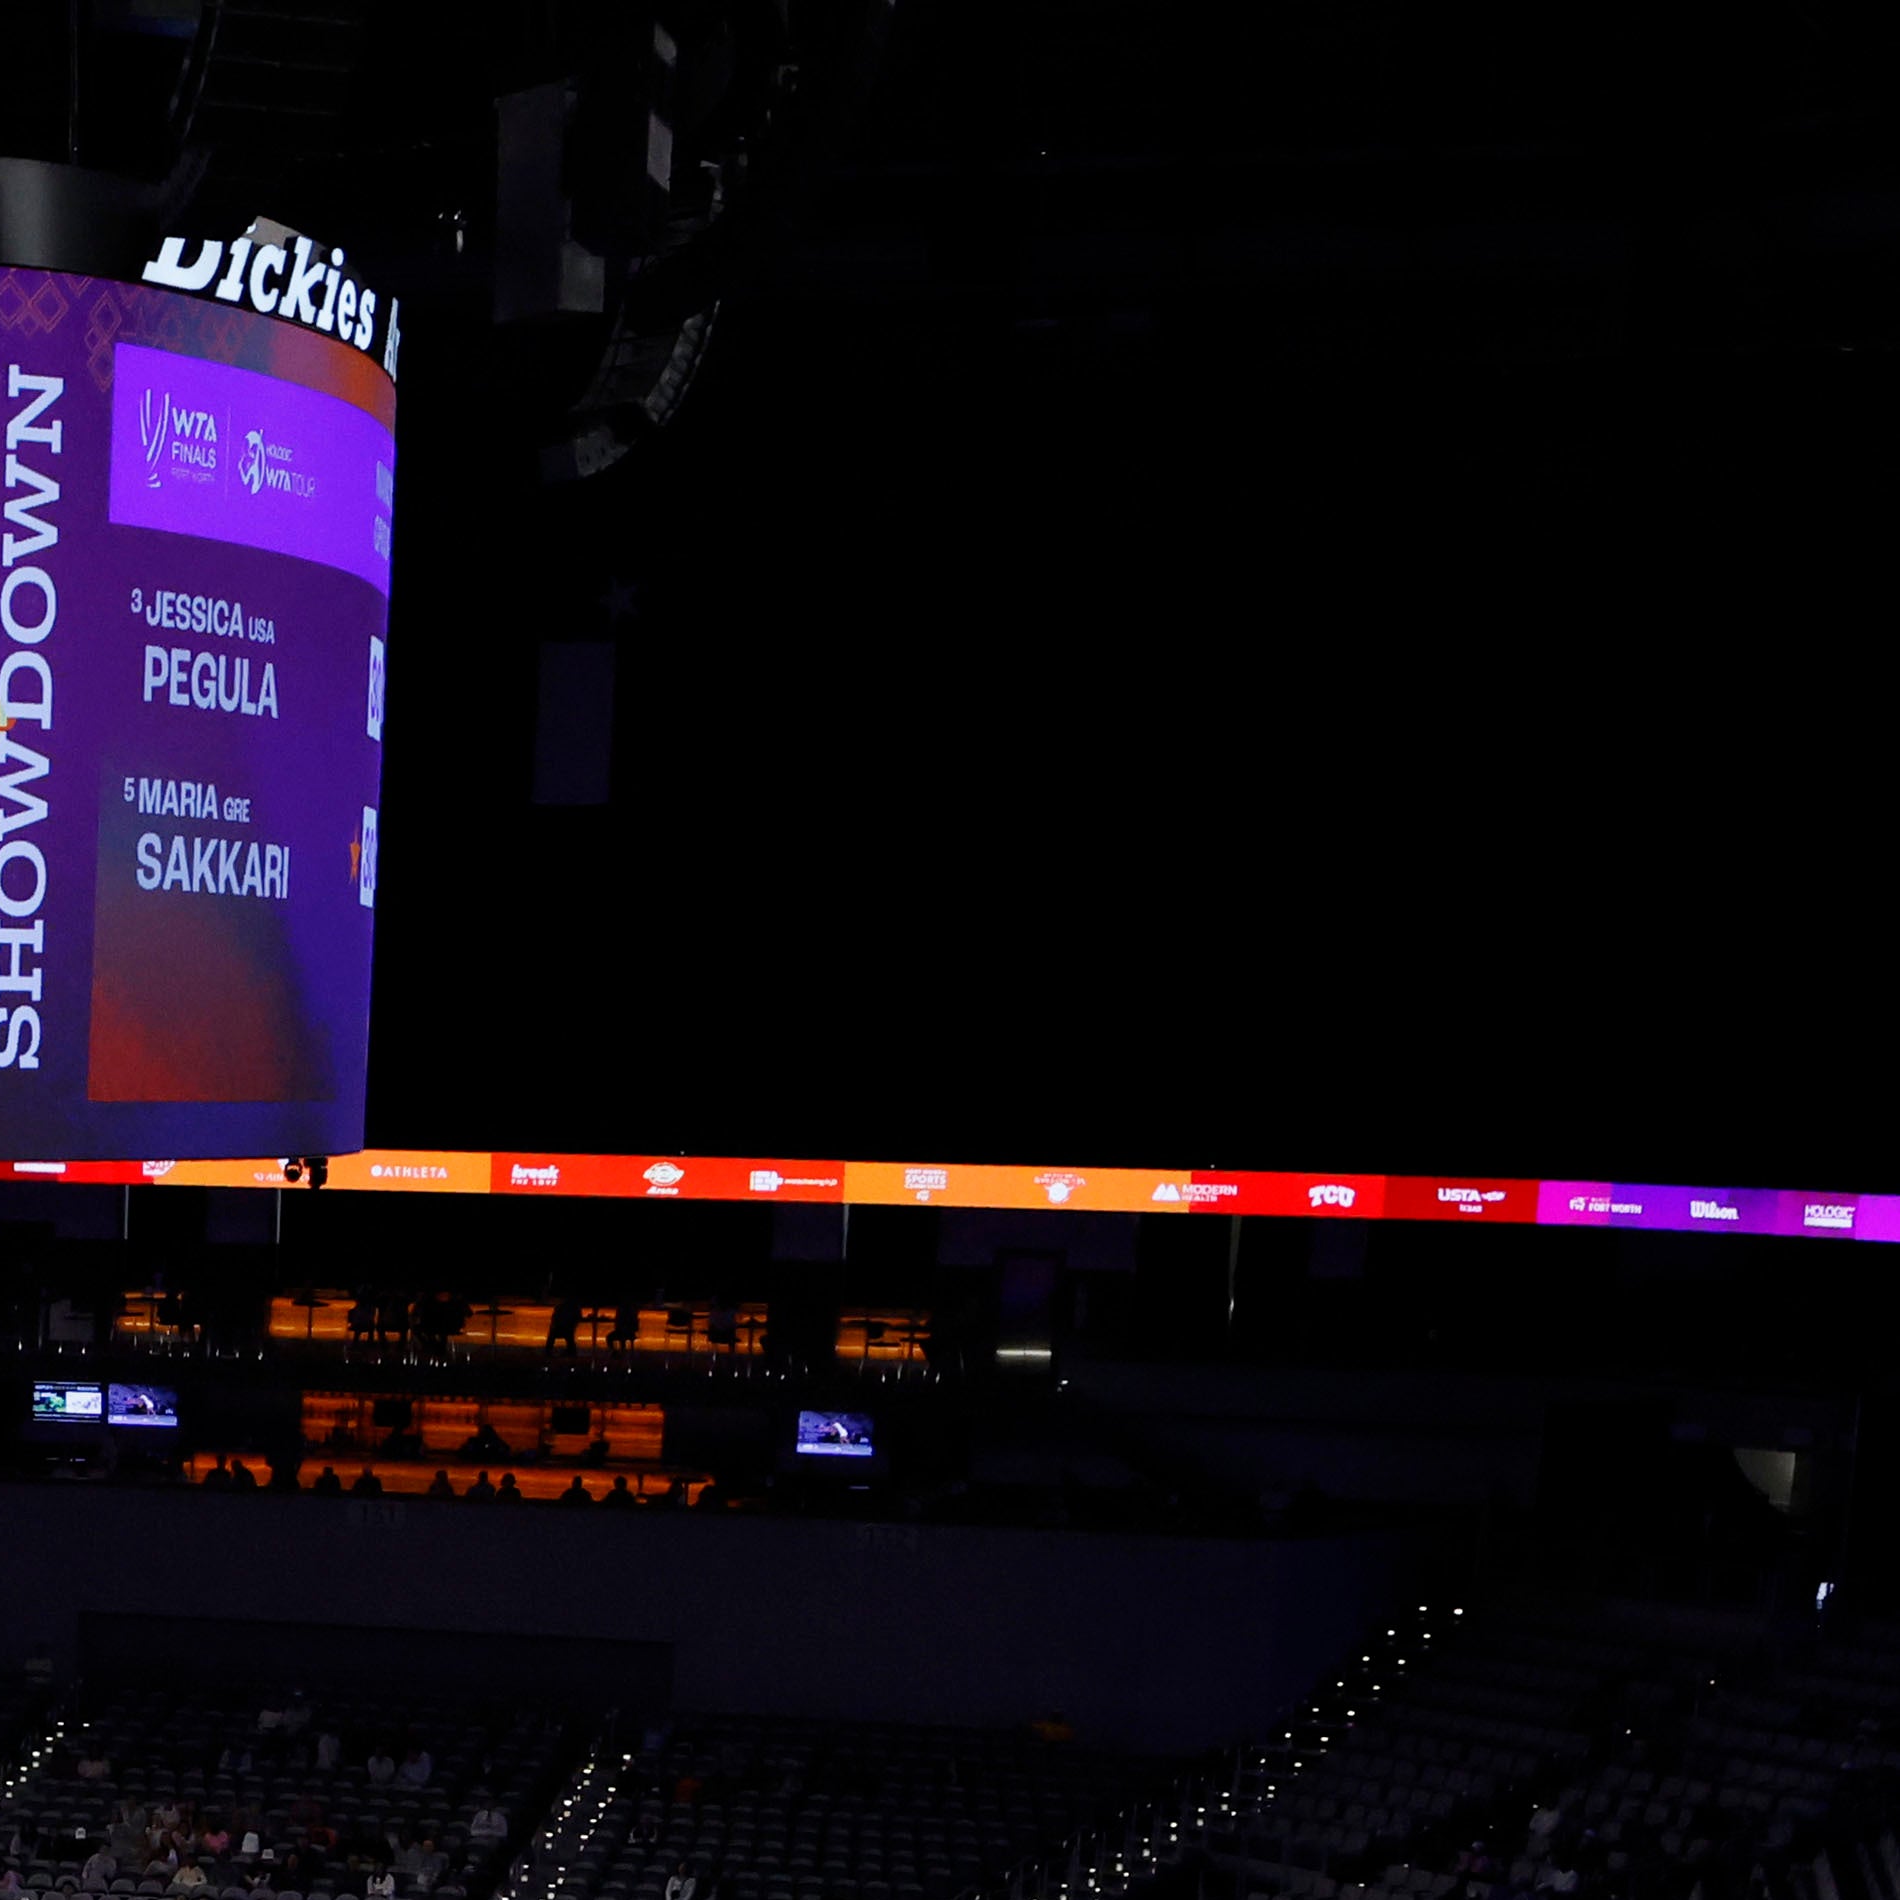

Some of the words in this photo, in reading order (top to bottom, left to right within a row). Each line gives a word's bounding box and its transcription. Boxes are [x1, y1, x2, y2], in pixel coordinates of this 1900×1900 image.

[141, 228, 377, 350] Dickies
[171, 405, 218, 444] WTA
[171, 446, 217, 470] FINALS
[131, 588, 144, 615] 3
[145, 590, 244, 639] JESSICA
[248, 616, 276, 645] USA
[143, 645, 279, 719] PEGULA
[123, 777, 136, 803] 5
[137, 778, 218, 821] MARIA
[222, 798, 251, 825] GRE
[136, 832, 291, 899] SAKKARI
[382, 1166, 448, 1179] ATHLETA
[1181, 1184, 1237, 1196] MODERN
[1309, 1185, 1355, 1207] TCU
[1438, 1188, 1481, 1202] USTA
[1690, 1200, 1739, 1220] Wilson
[1806, 1205, 1855, 1219] HOLOGIC
